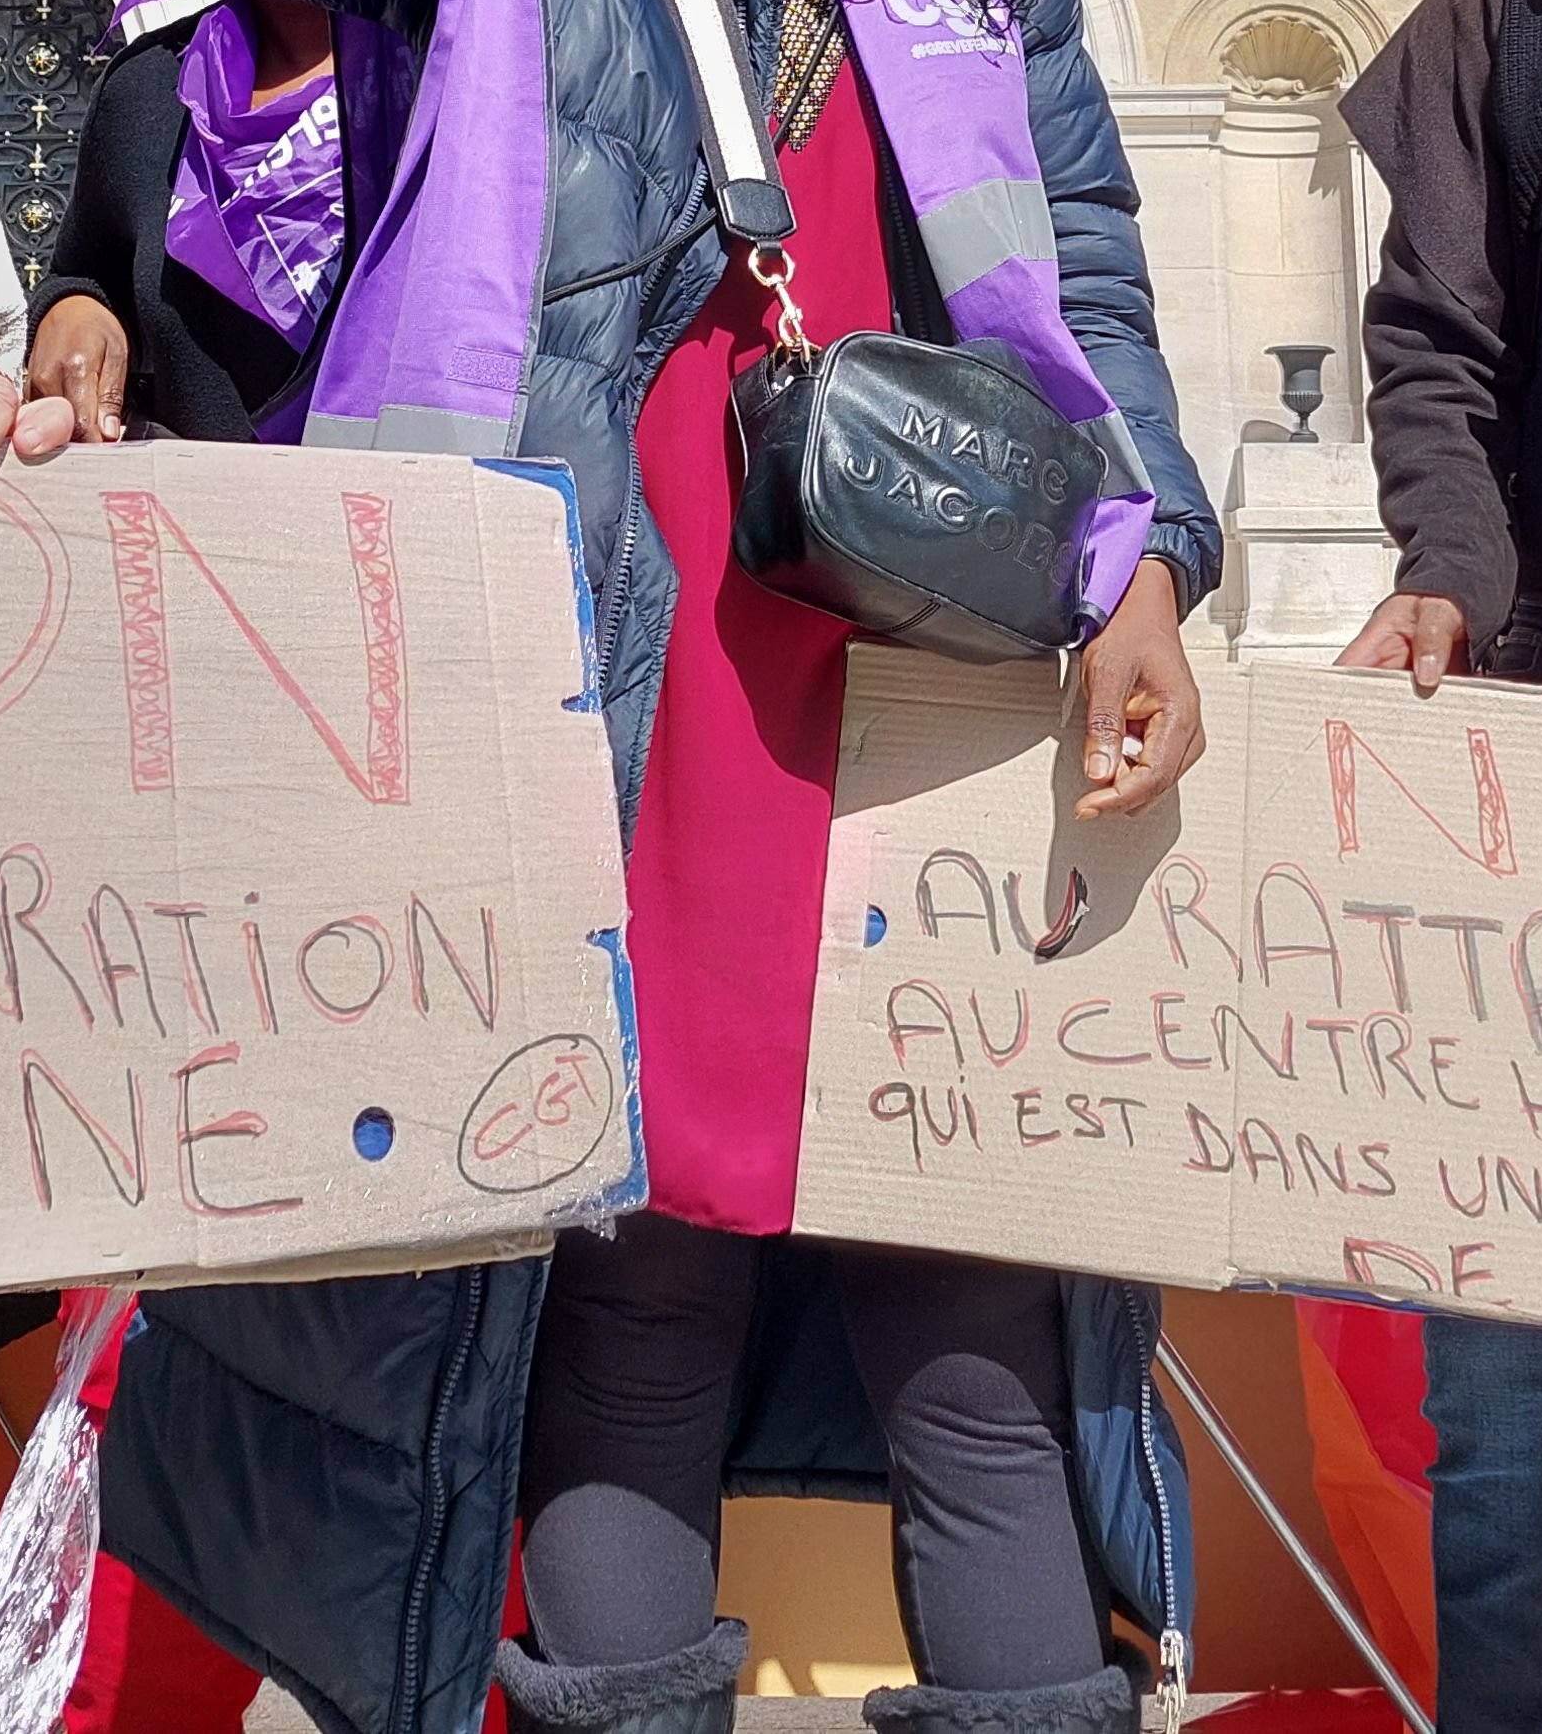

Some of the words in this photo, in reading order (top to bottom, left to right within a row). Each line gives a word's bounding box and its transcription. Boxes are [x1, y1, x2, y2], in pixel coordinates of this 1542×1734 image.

[899, 403, 1070, 504] MARC
[842, 452, 1075, 586] JACOBS
[916, 848, 1089, 964] AU
[886, 978, 1030, 1067] AU
[1058, 992, 1482, 1112] CENTRE
[472, 1048, 601, 1162] CGT
[1016, 1086, 1148, 1149] EST
[1183, 1102, 1397, 1197] DANS
